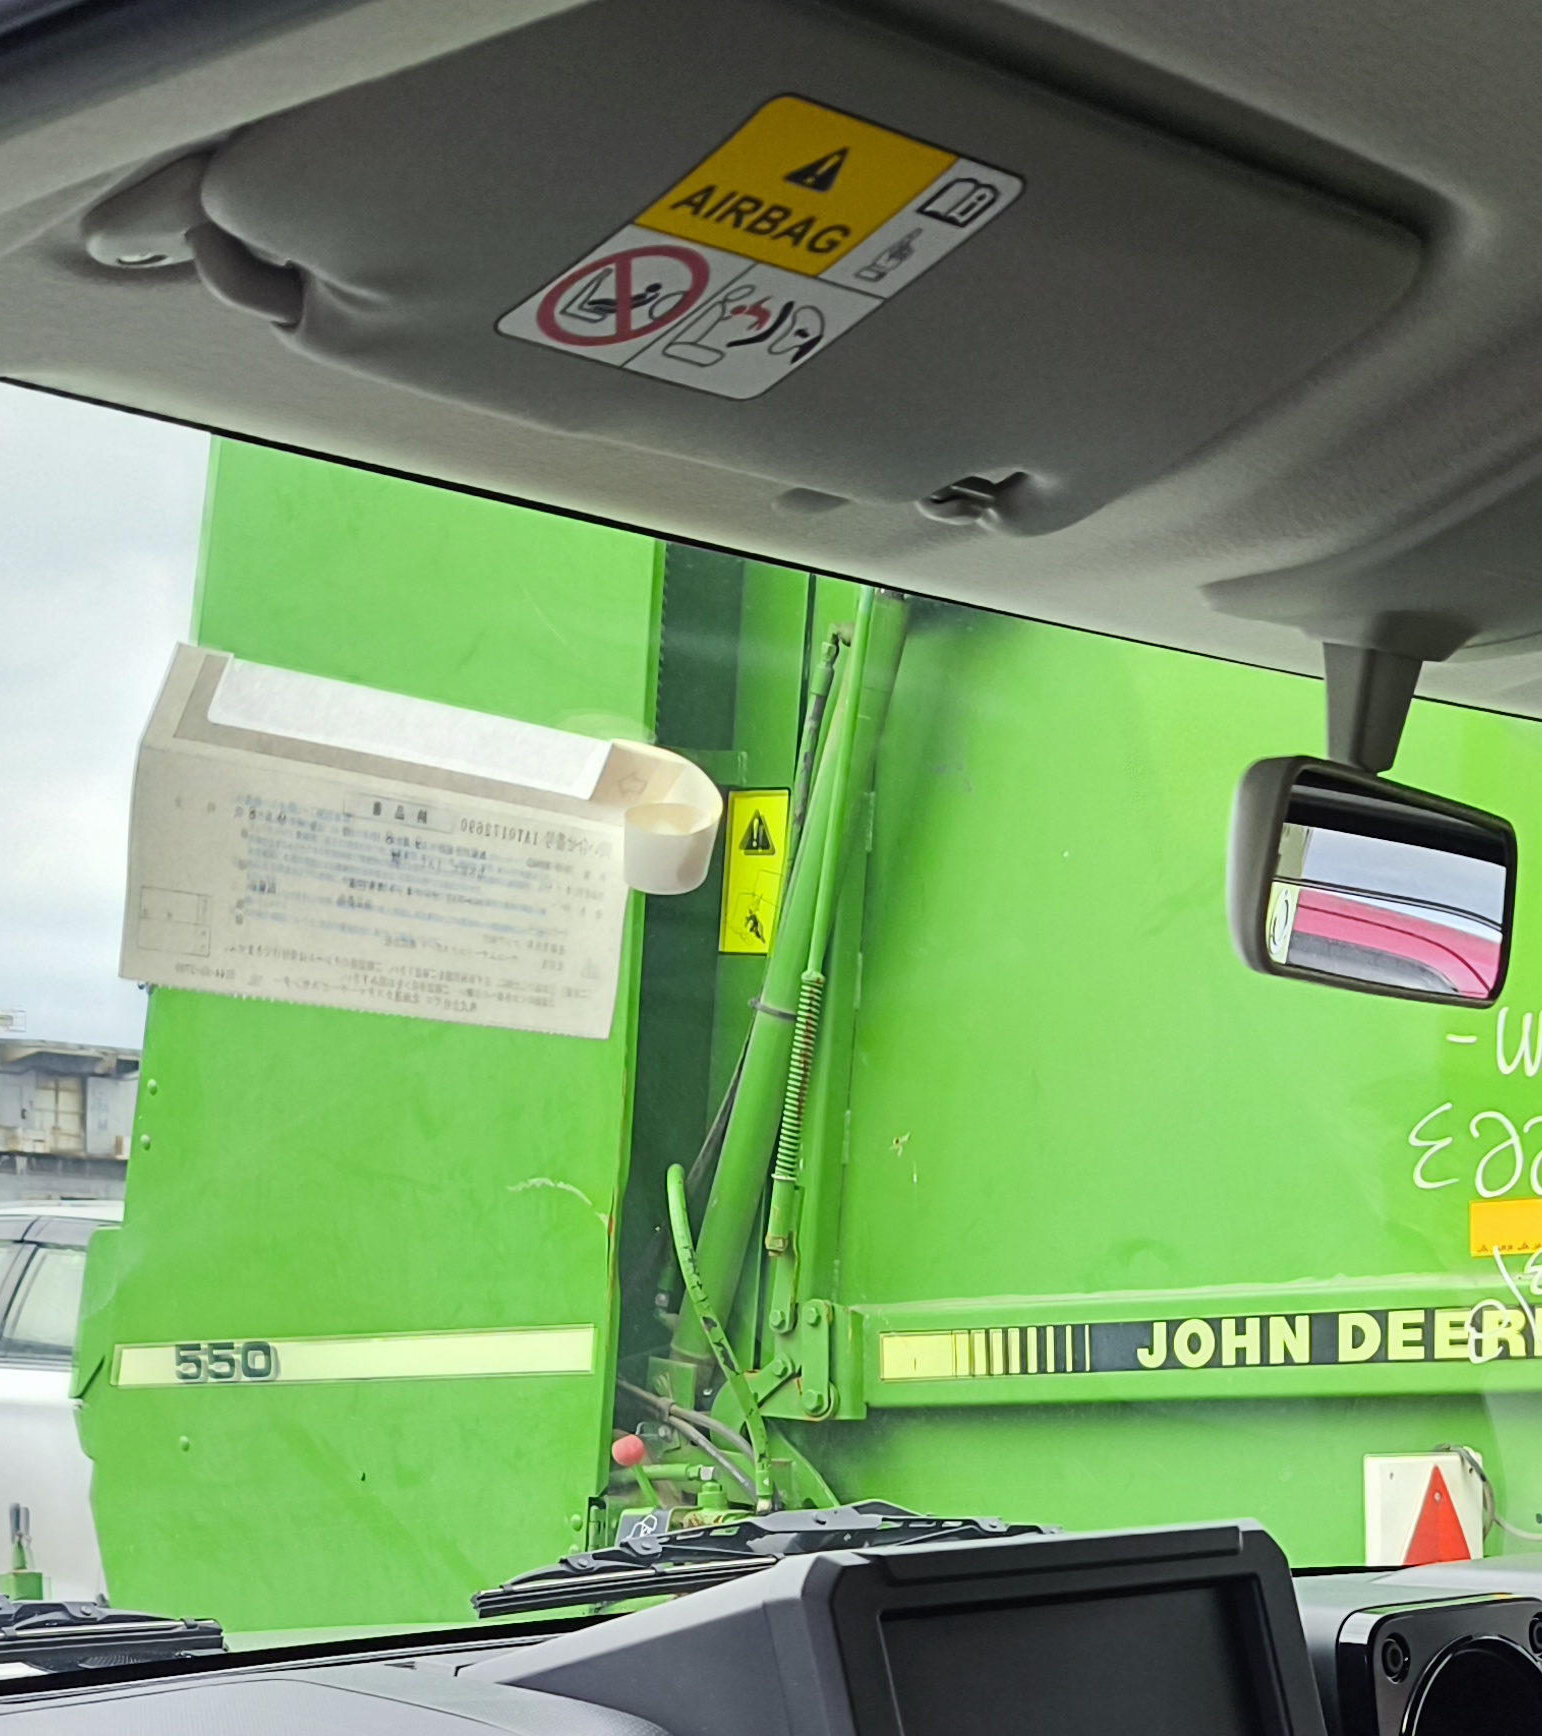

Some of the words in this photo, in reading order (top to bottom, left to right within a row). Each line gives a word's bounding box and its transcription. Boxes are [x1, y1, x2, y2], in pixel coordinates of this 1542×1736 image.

[669, 184, 853, 255] AIRBAG
[174, 1340, 274, 1382] 550
[1136, 1315, 1310, 1369] JOHN
